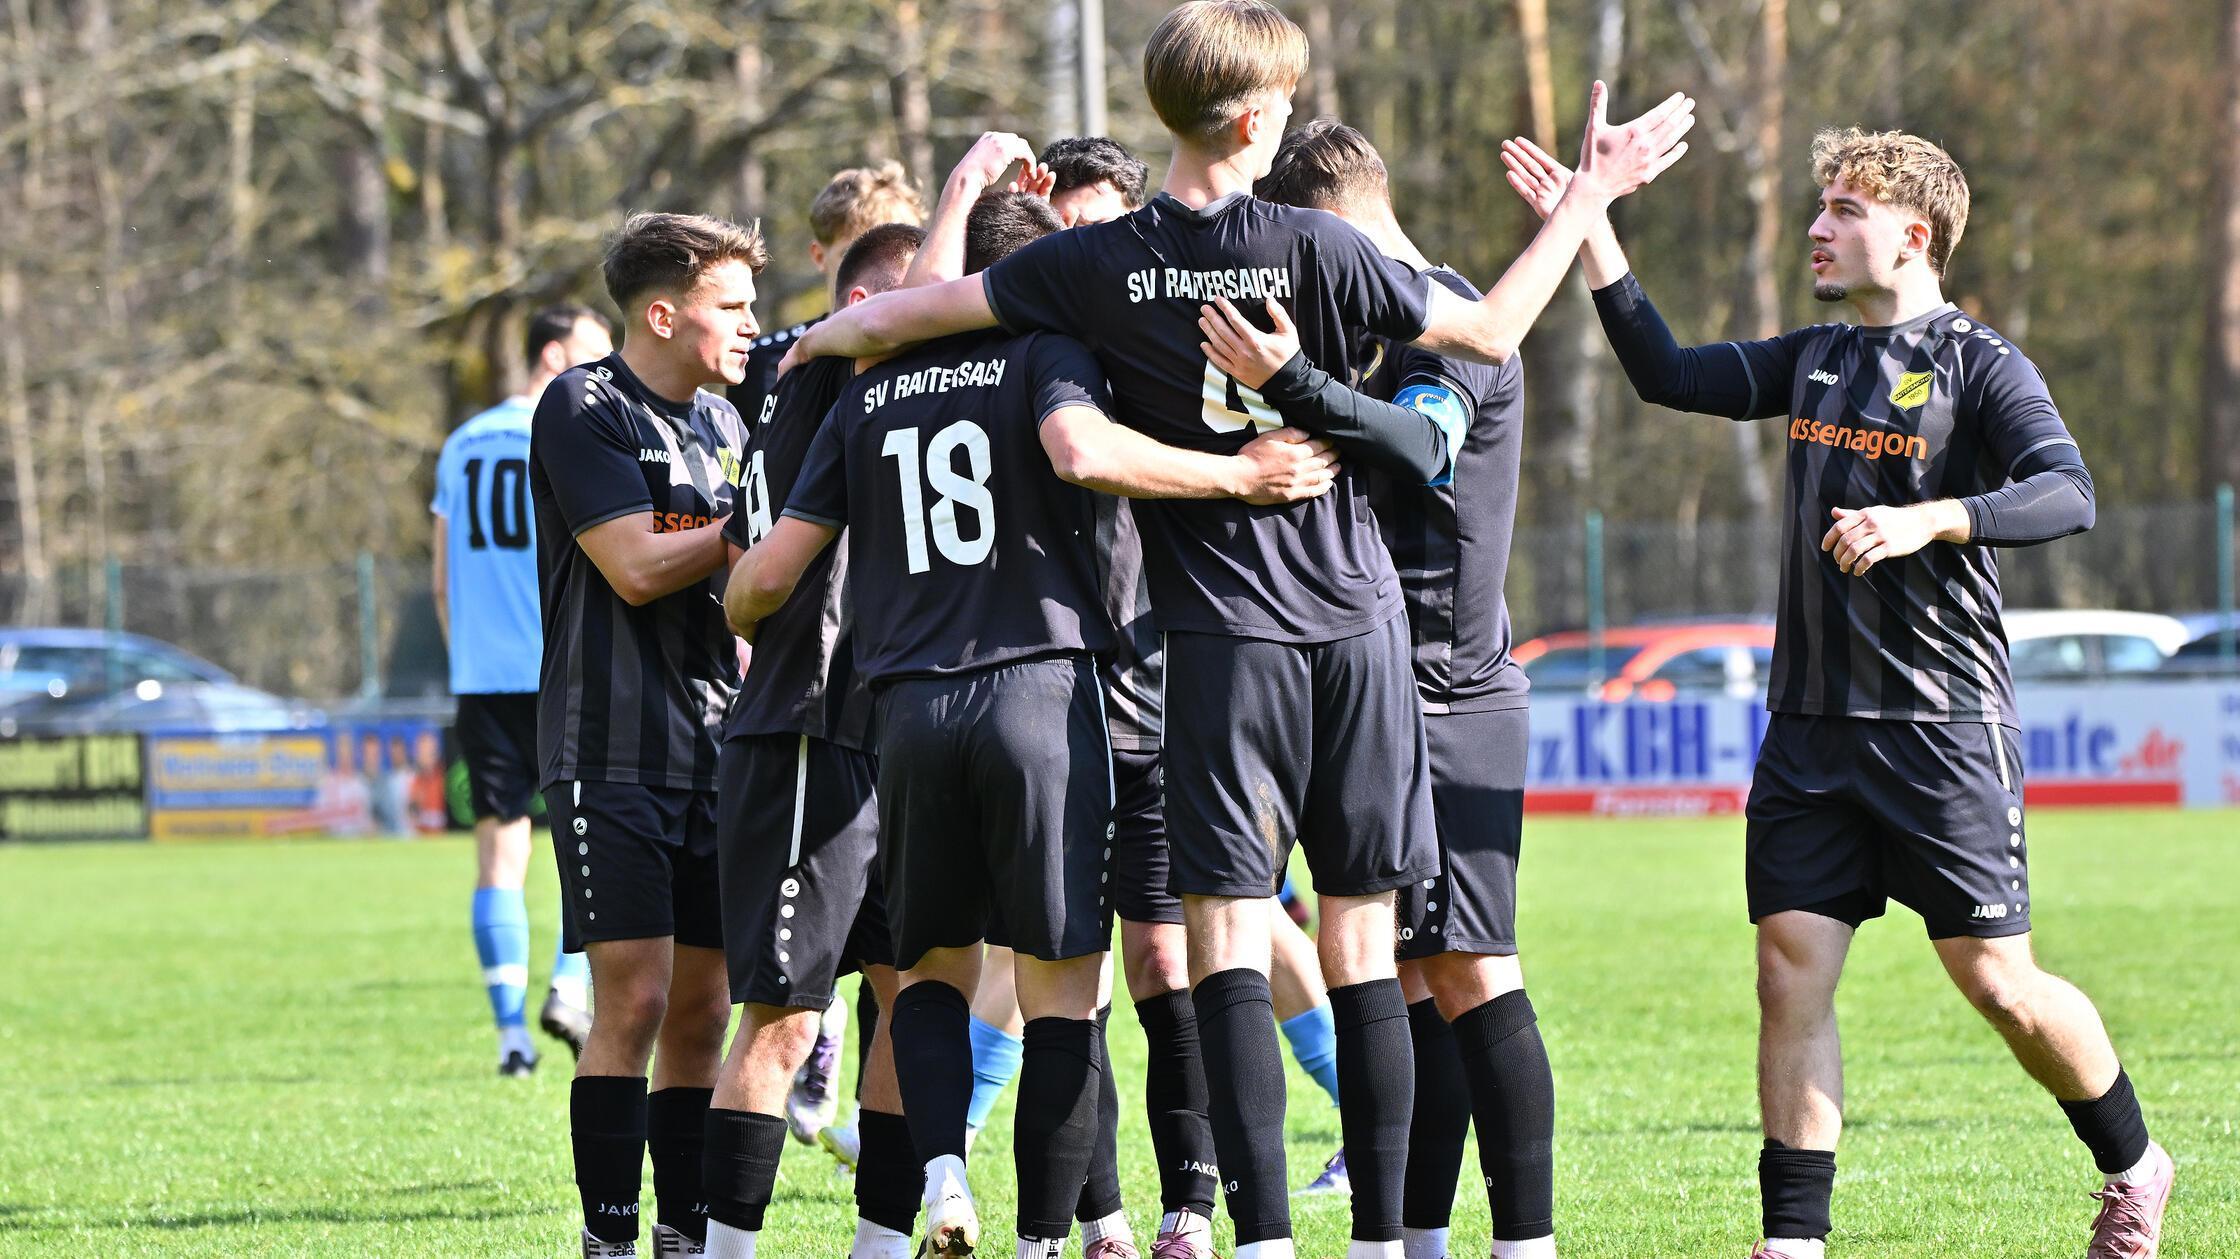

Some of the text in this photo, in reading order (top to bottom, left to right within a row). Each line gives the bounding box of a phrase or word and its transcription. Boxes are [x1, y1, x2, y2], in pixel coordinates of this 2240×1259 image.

[1127, 268, 1156, 303] SV
[864, 380, 889, 414] SV
[464, 458, 530, 550] 10
[881, 419, 996, 575] 18
[1971, 903, 2008, 919] JAKO
[598, 1202, 639, 1217] JAKO
